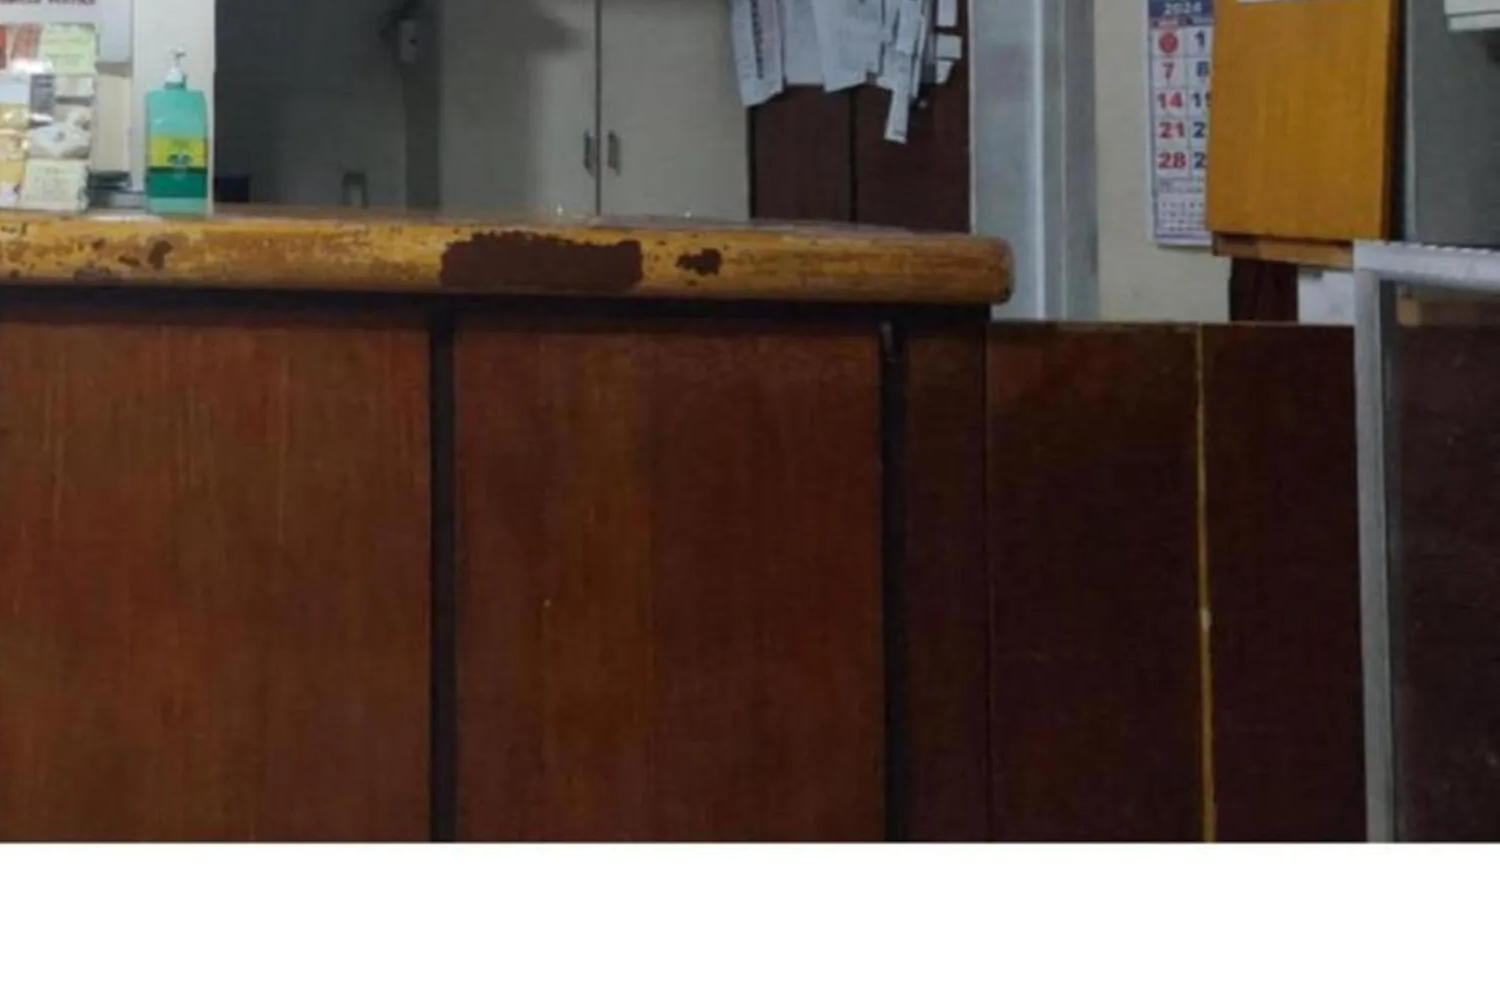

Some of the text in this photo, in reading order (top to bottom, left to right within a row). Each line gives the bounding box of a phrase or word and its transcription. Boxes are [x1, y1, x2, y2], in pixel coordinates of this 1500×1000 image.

[1195, 30, 1206, 47] 1
[1162, 61, 1175, 80] 7
[1157, 91, 1212, 109] 14 1
[1159, 120, 1207, 138] 21 2
[1158, 150, 1207, 169] 28 2
